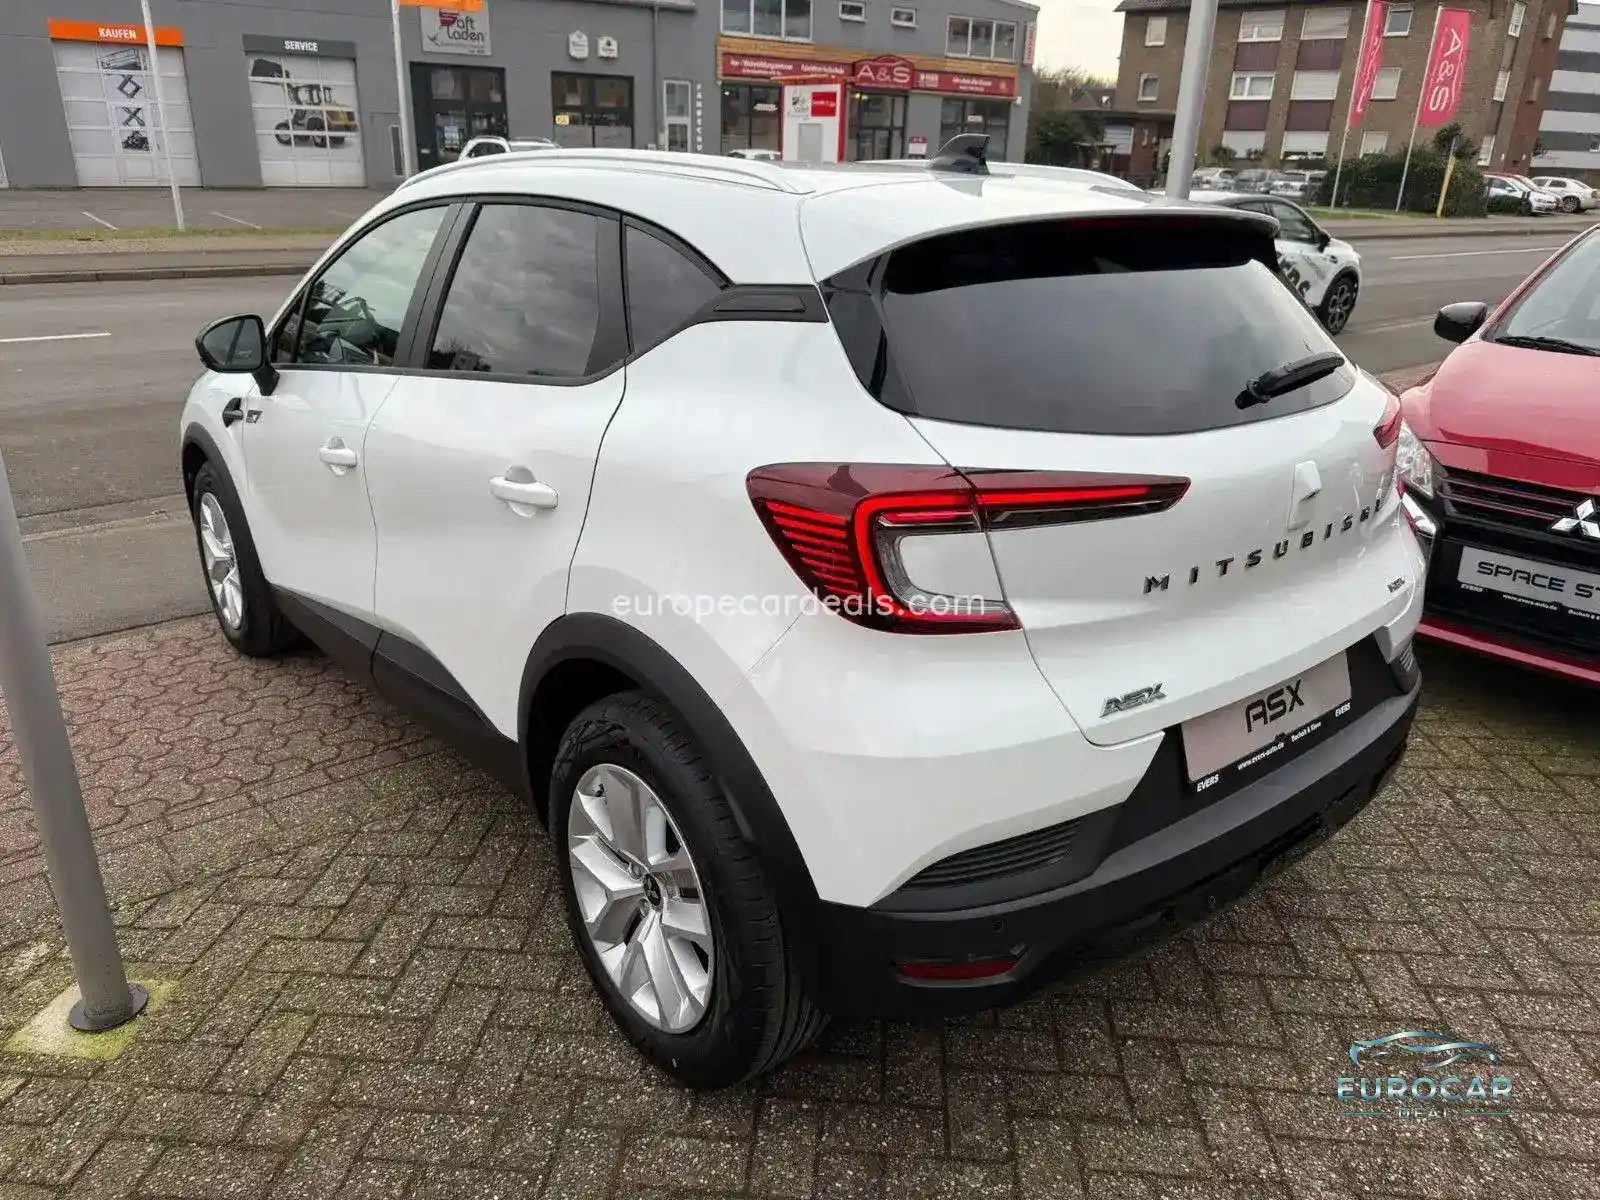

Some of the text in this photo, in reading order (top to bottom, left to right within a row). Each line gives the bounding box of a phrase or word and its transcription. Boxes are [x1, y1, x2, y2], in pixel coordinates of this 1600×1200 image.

[98, 26, 137, 40] KAUFEN
[284, 40, 319, 52] SERVICE
[856, 64, 911, 83] A&S
[1429, 28, 1462, 111] A&S
[1143, 498, 1381, 594] MITSUBISHI
[1477, 561, 1600, 599] SPACE S
[1098, 682, 1167, 718] ASX
[1246, 680, 1305, 733] ASX
[1196, 774, 1219, 793] EVERS
[1335, 702, 1351, 718] EVERS
